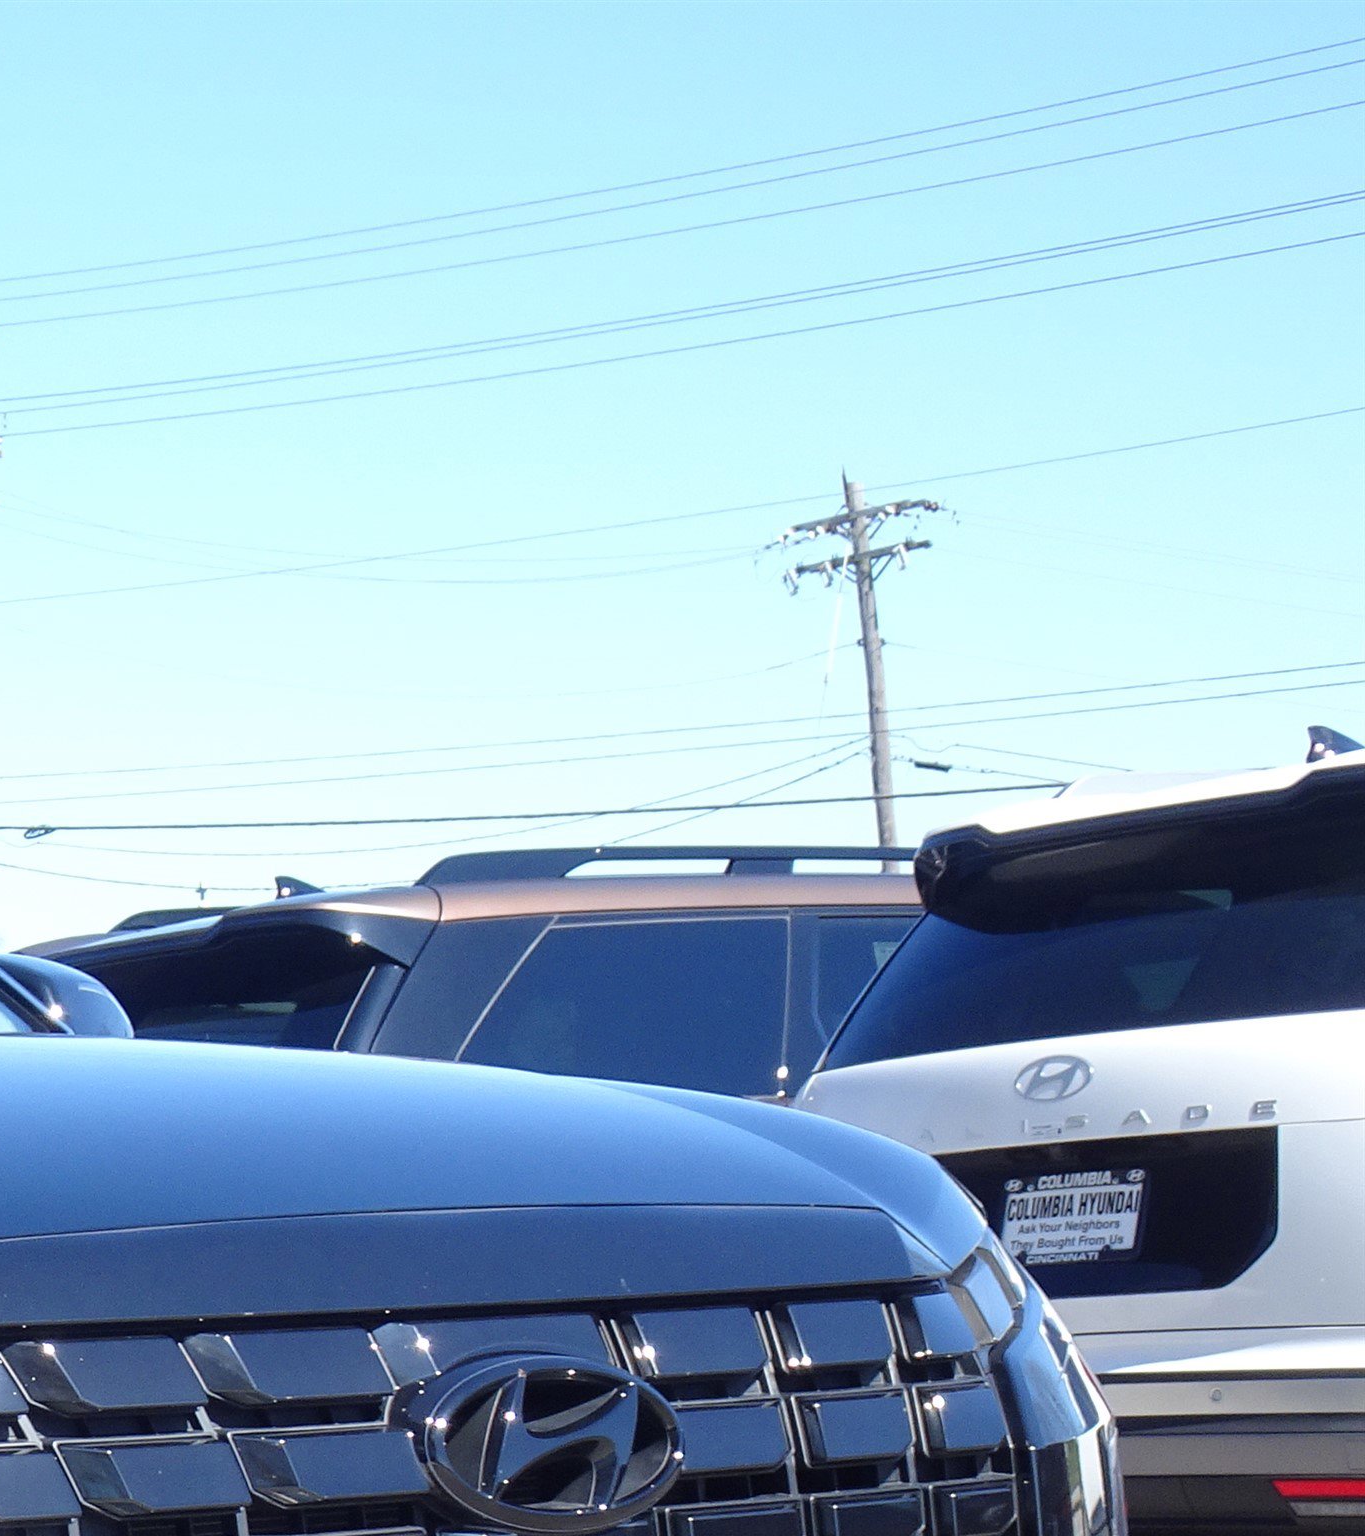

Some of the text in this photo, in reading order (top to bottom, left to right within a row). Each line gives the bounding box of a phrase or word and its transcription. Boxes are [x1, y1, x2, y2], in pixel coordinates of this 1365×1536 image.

[1037, 1171, 1112, 1190] COLUMBIA
[1008, 1190, 1142, 1221] COLUMBIA HYUNDAI
[1018, 1219, 1120, 1235] Ask Your Neighbors
[1010, 1234, 1124, 1252] They Bought From Us
[1026, 1253, 1099, 1264] CINCINNATI
